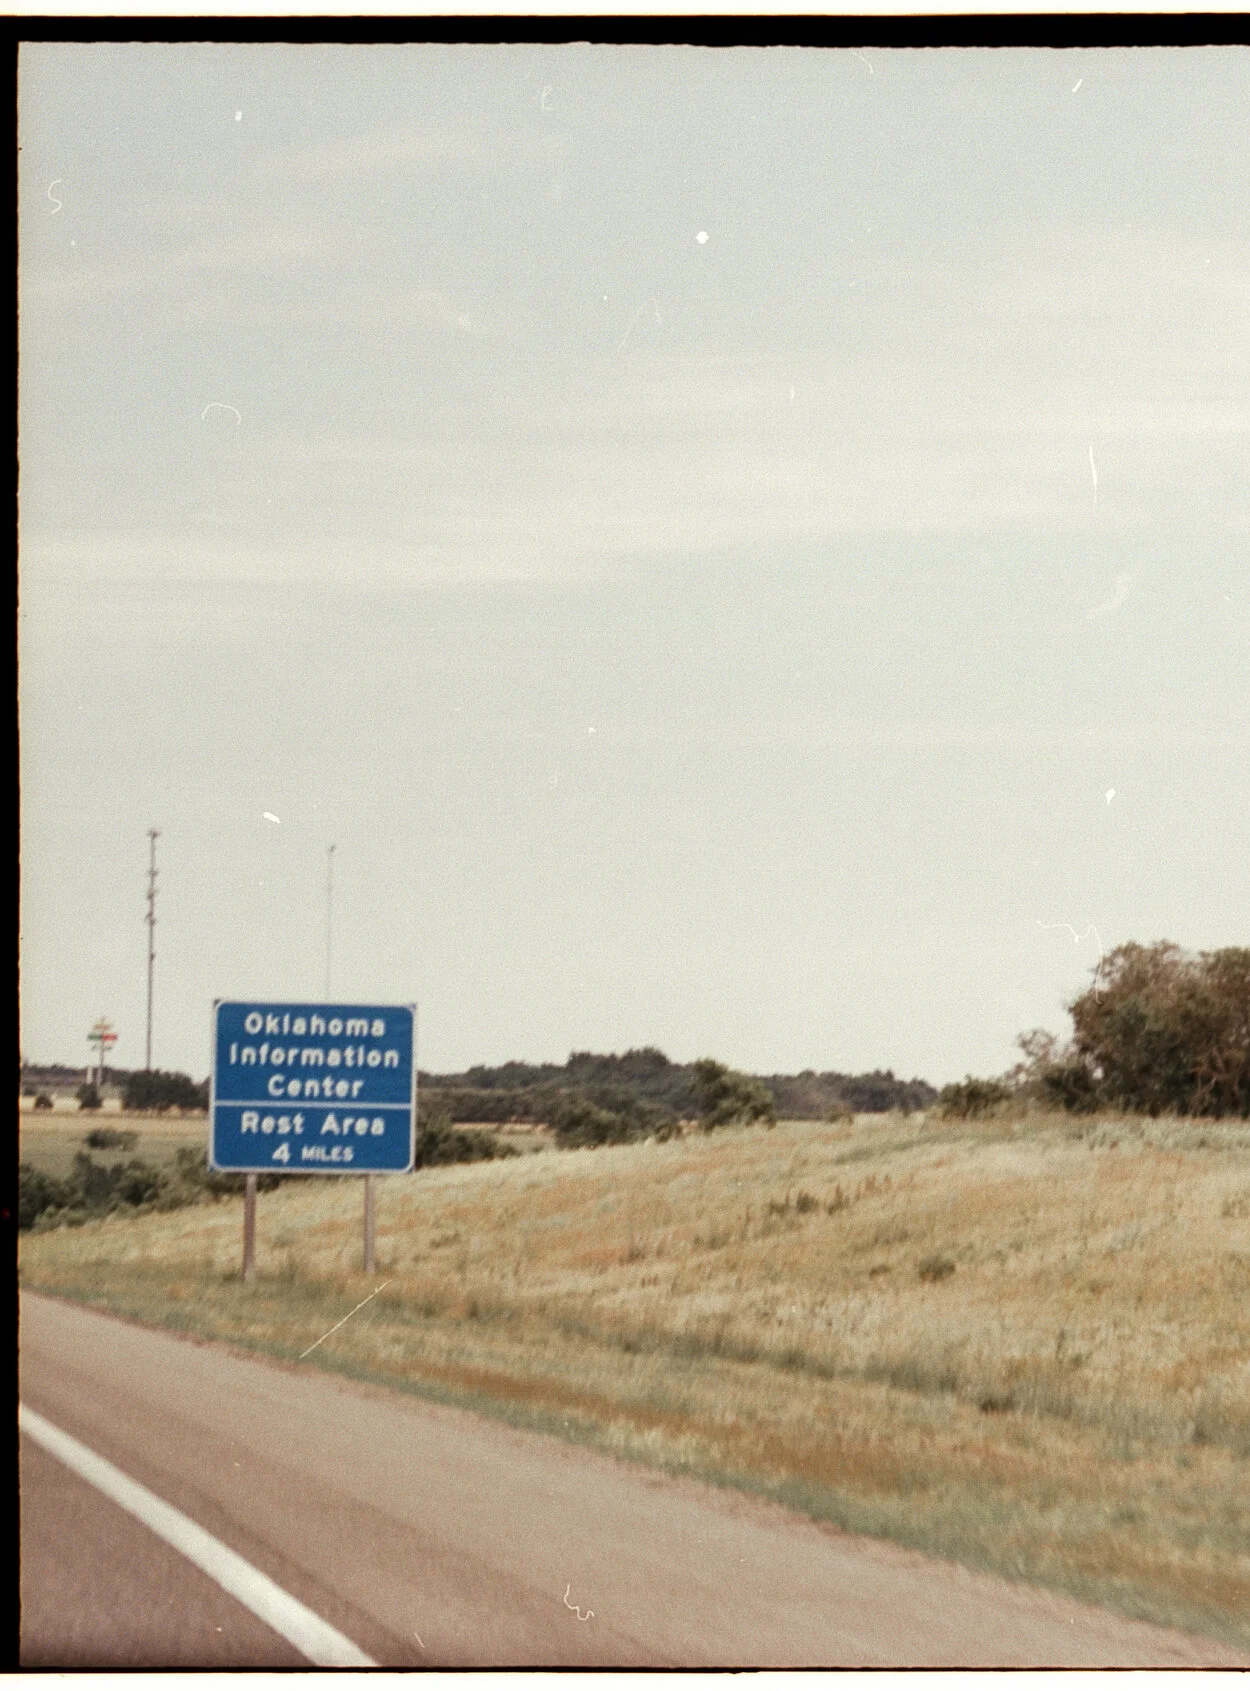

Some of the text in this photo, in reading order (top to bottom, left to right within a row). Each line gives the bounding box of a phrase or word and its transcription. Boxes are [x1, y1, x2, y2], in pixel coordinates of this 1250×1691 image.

[244, 1012, 386, 1037] Oklahoma
[229, 1043, 399, 1068] Information
[267, 1074, 364, 1098] Center
[241, 1111, 385, 1136] Rest Area
[272, 1143, 354, 1164] 4 MILES
